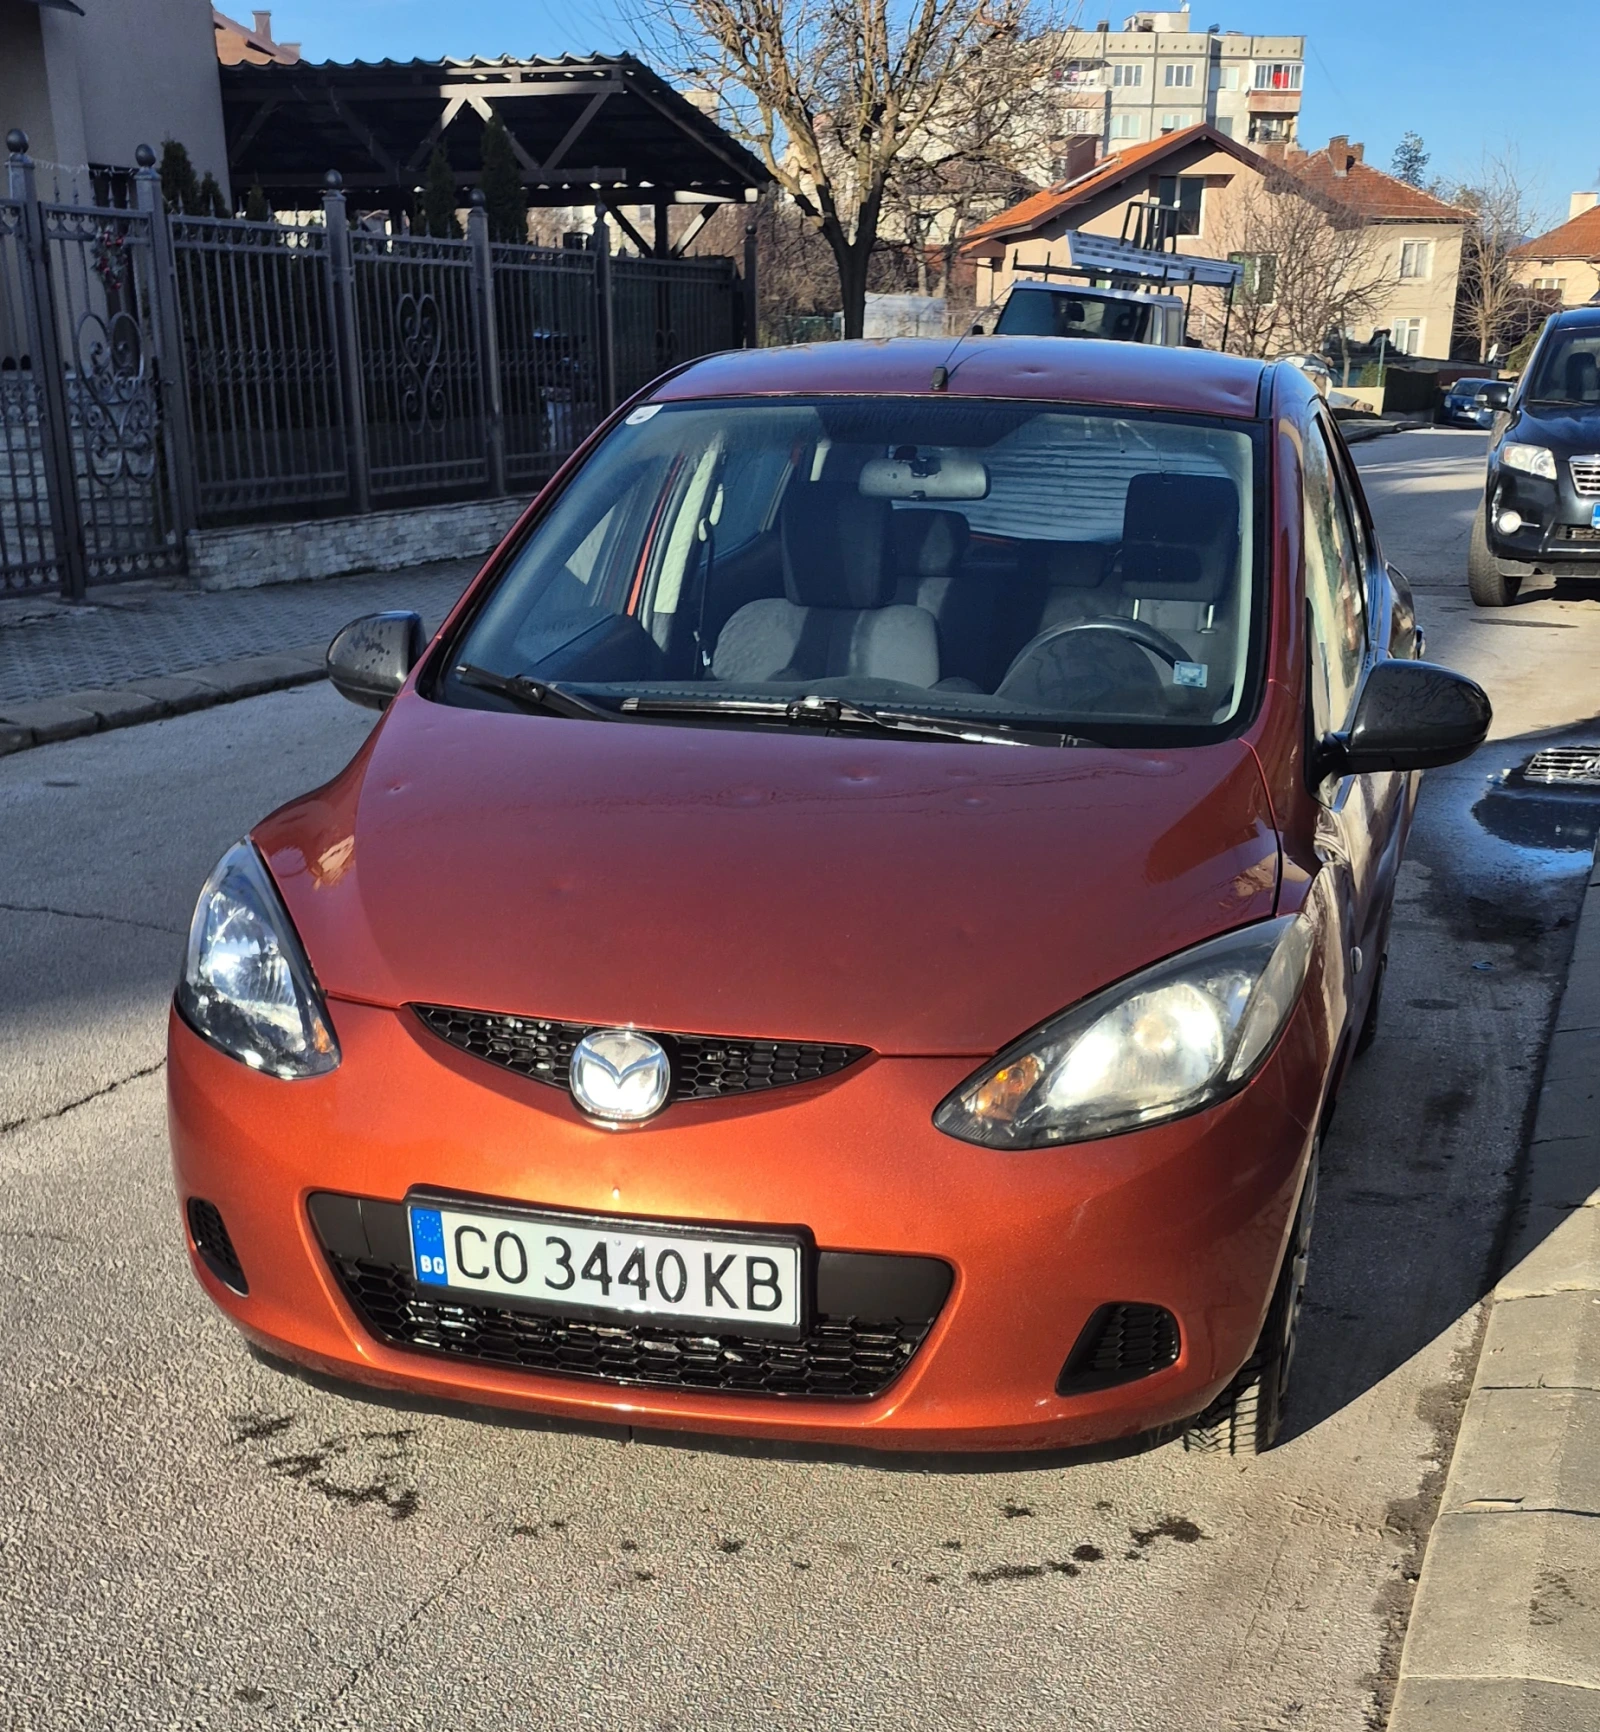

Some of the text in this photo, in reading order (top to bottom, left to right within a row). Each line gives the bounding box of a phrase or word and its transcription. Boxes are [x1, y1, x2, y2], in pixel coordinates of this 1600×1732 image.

[420, 1254, 445, 1275] BG
[454, 1225, 783, 1312] CO 3440 KB
